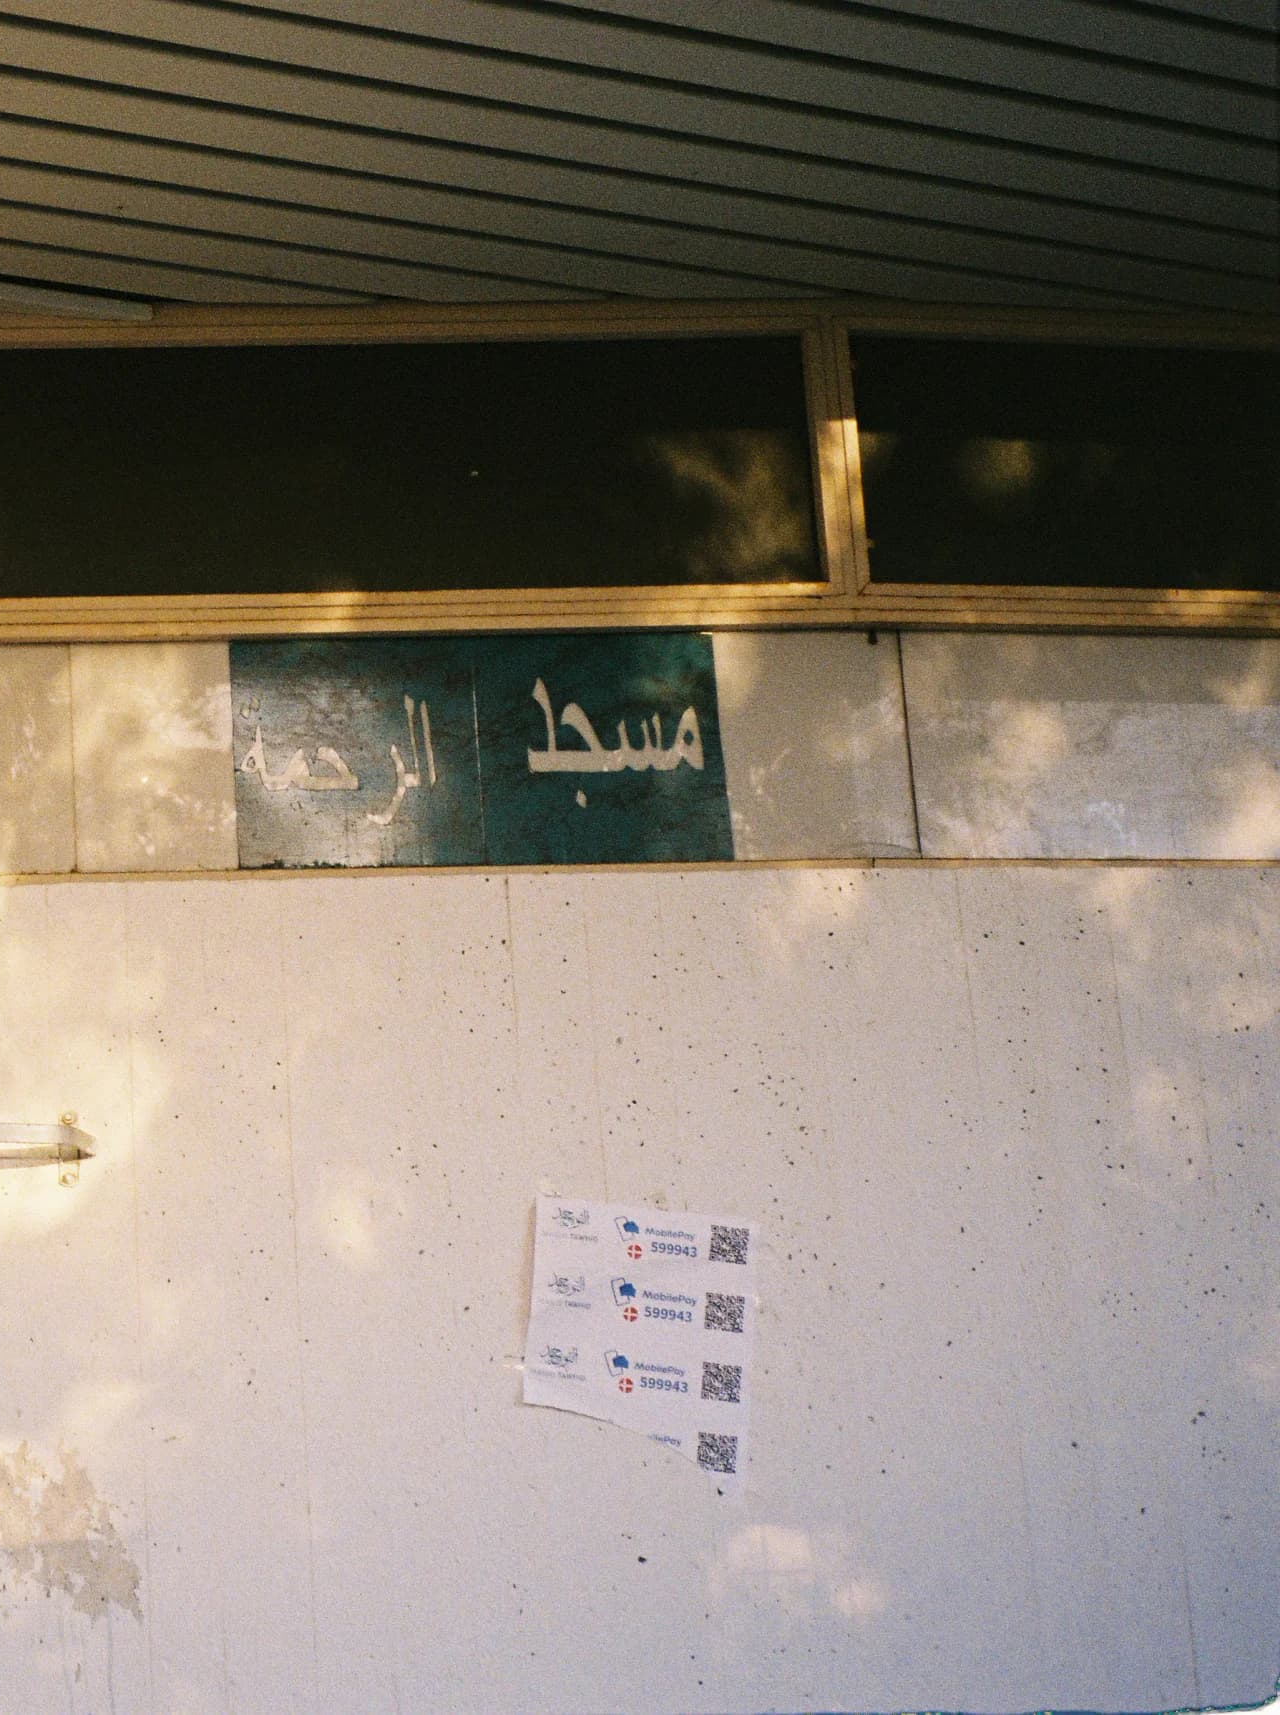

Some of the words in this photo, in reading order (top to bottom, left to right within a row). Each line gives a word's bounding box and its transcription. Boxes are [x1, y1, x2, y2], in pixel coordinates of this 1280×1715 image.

[527, 677, 704, 808] مسجد
[239, 694, 436, 826] الرحمة
[644, 1227, 695, 1242] MobilePay
[651, 1242, 698, 1258] 599943
[642, 1289, 697, 1307] MobilePay
[644, 1306, 693, 1323] 599943
[634, 1362, 685, 1378] MobilePay
[640, 1377, 689, 1393] 599943
